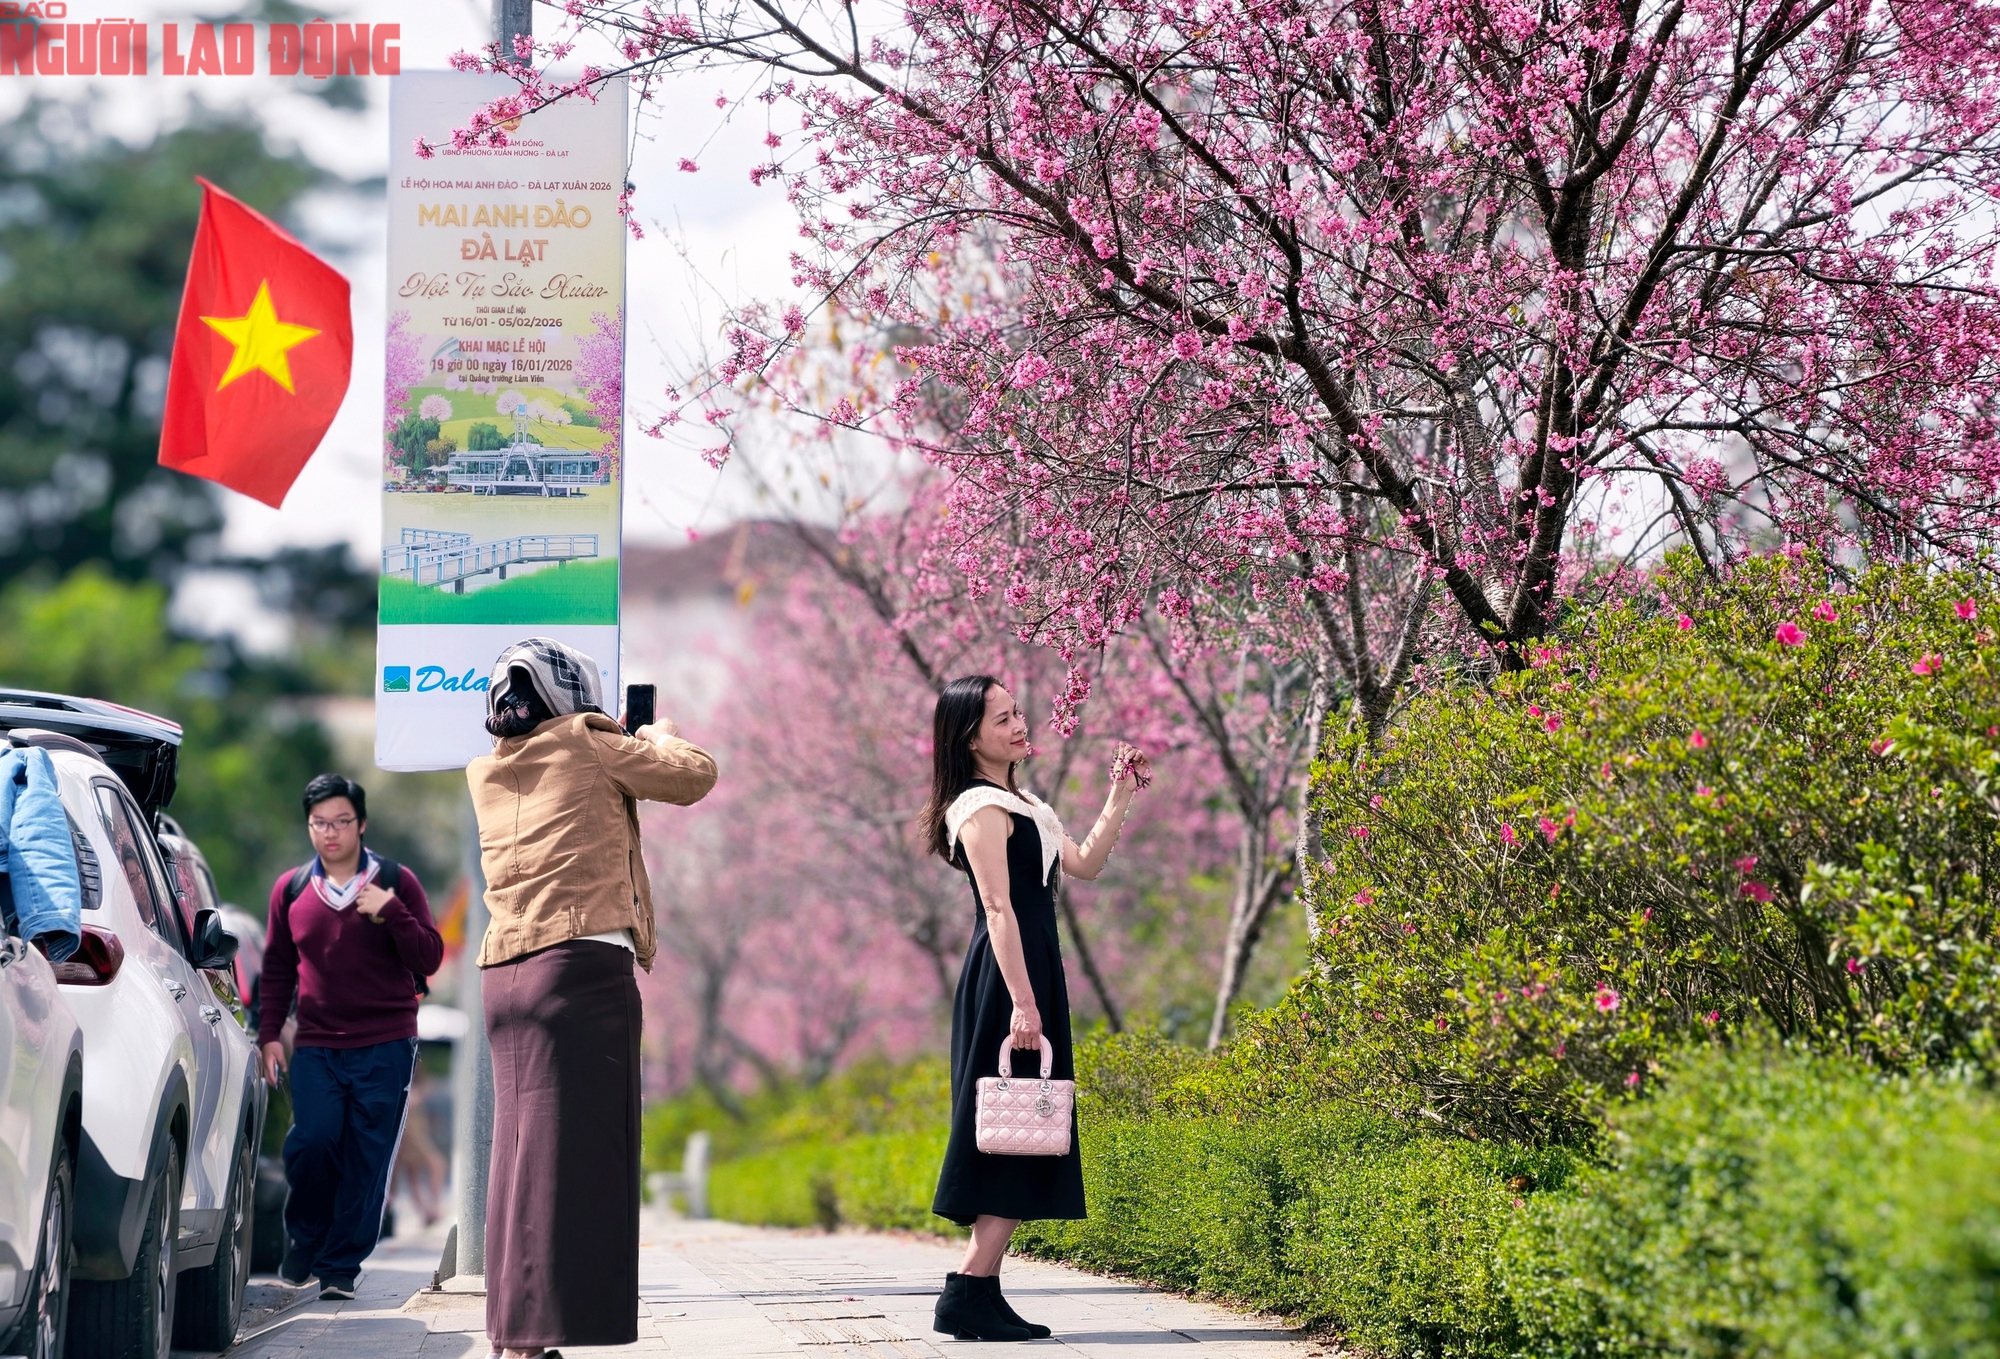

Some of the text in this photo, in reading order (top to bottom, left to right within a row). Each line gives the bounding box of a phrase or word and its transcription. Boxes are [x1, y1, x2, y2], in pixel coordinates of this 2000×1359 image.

[494, 148, 512, 156] XUÂN
[514, 149, 539, 157] HƯƠNG
[557, 150, 569, 158] LẠT
[401, 177, 411, 189] LỄ
[413, 178, 430, 191] HỘI
[433, 181, 453, 189] HOA
[456, 181, 472, 189] MAI
[475, 181, 495, 189] ANH
[497, 179, 518, 189] ĐÀO
[528, 180, 541, 190] ĐÀ
[544, 182, 560, 192] LẠT
[562, 179, 587, 191] XUÂN
[590, 182, 611, 191] 2026
[418, 198, 592, 229] MAI ANH ĐÀO
[460, 232, 549, 268] ĐÀ LẠT
[398, 272, 608, 301] Hội Tụ Sắc Xuân
[491, 306, 505, 314] GIAN
[442, 317, 457, 327] Từ
[460, 316, 488, 327] 16/01
[498, 316, 563, 328] 05/02/2026
[458, 338, 546, 355] KHAI MẠC LỄ HỘI
[431, 359, 444, 370] 19
[466, 359, 479, 370] 00
[482, 359, 507, 373] ngày
[511, 359, 572, 371] 16/01/2026
[458, 374, 466, 383] tại
[514, 374, 528, 383] Lâm
